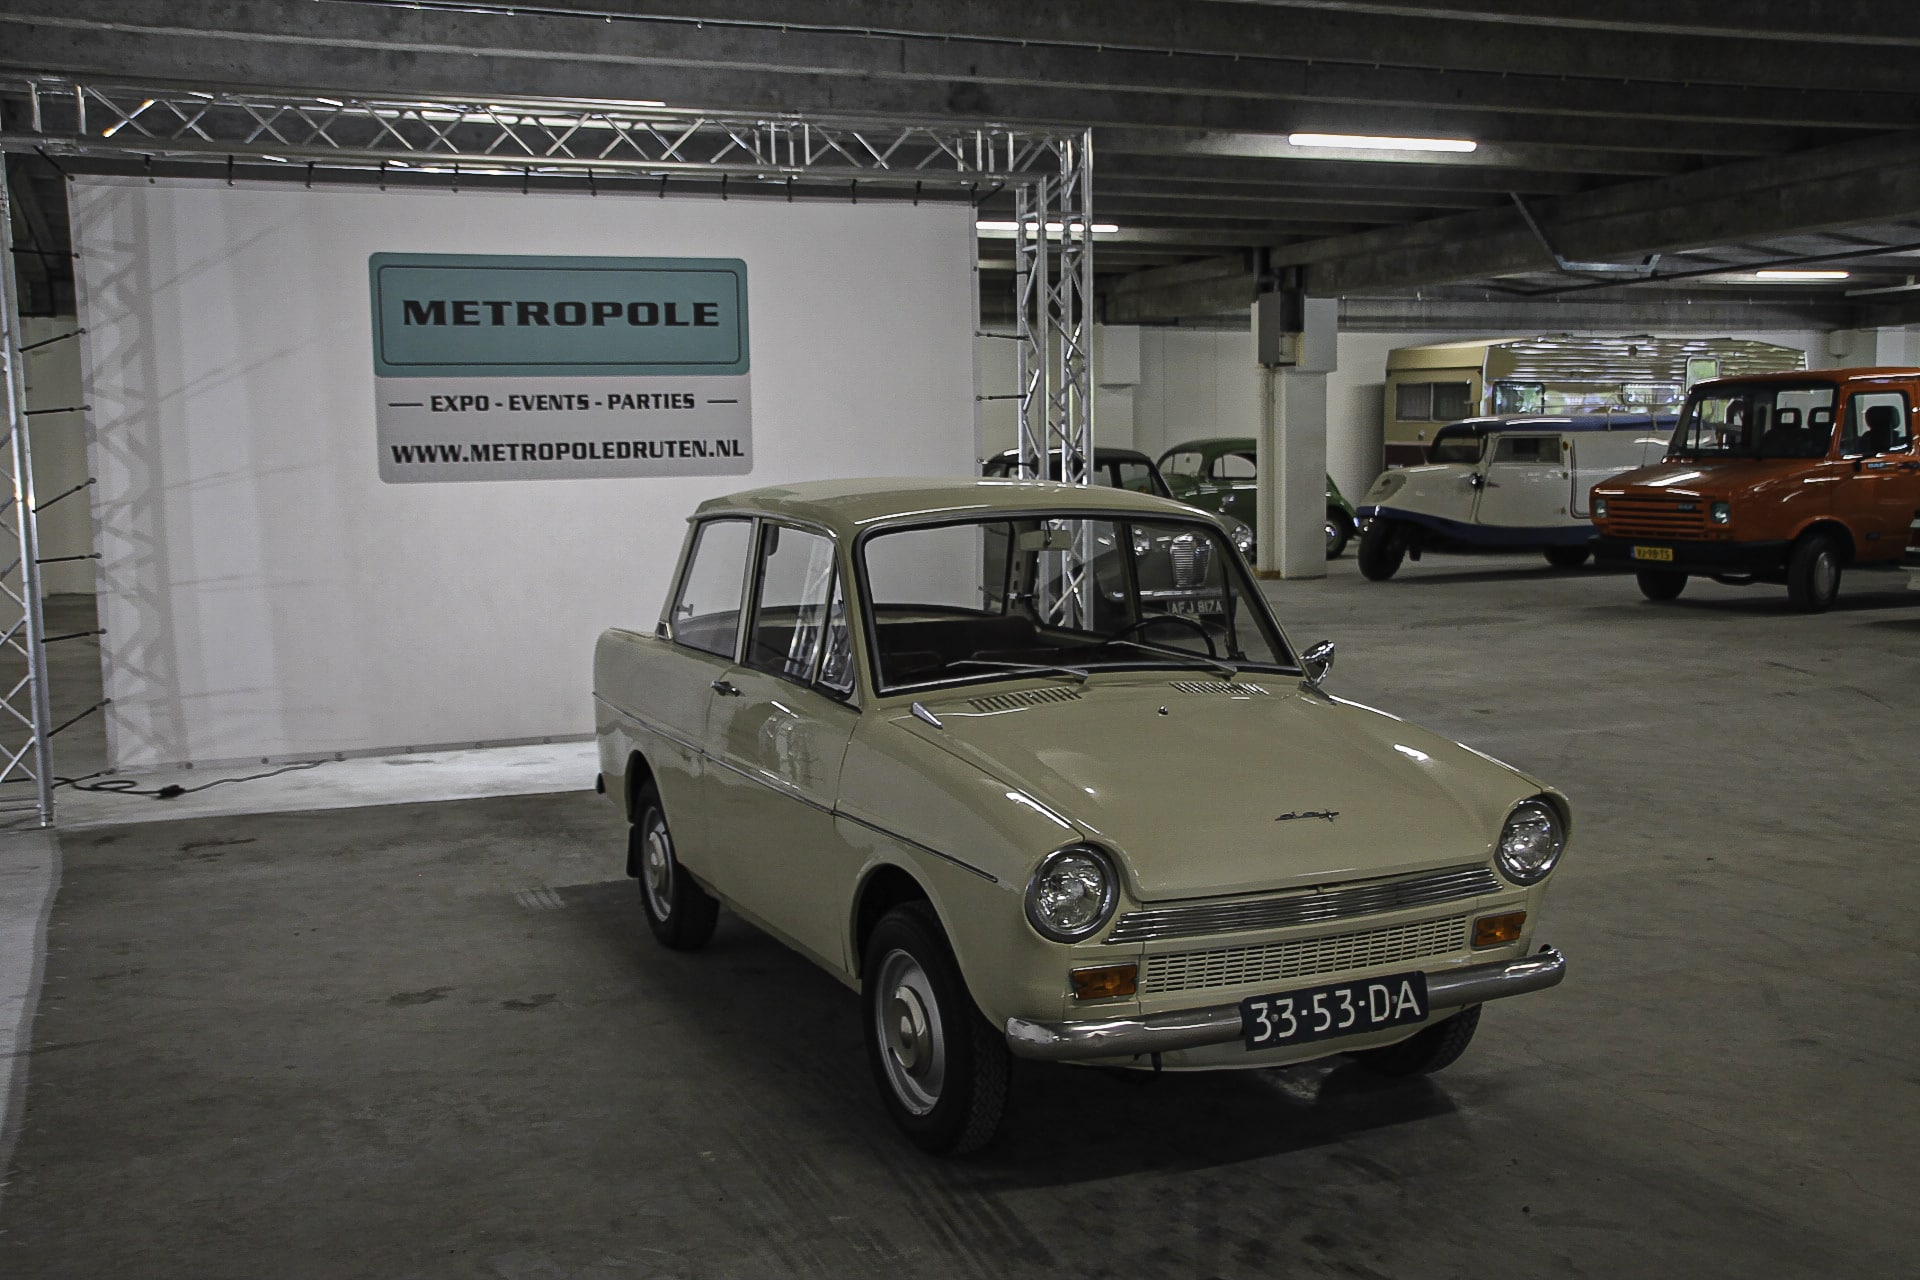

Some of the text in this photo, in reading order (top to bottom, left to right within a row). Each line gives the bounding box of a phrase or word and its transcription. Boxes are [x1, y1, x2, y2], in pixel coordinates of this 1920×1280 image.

[402, 299, 720, 327] METROPOLE
[431, 395, 489, 413] EXPO
[508, 394, 590, 412] EVENTS
[607, 393, 695, 410] PARTIES
[391, 439, 745, 464] WWW.METROPOLEDRUTEN.NL
